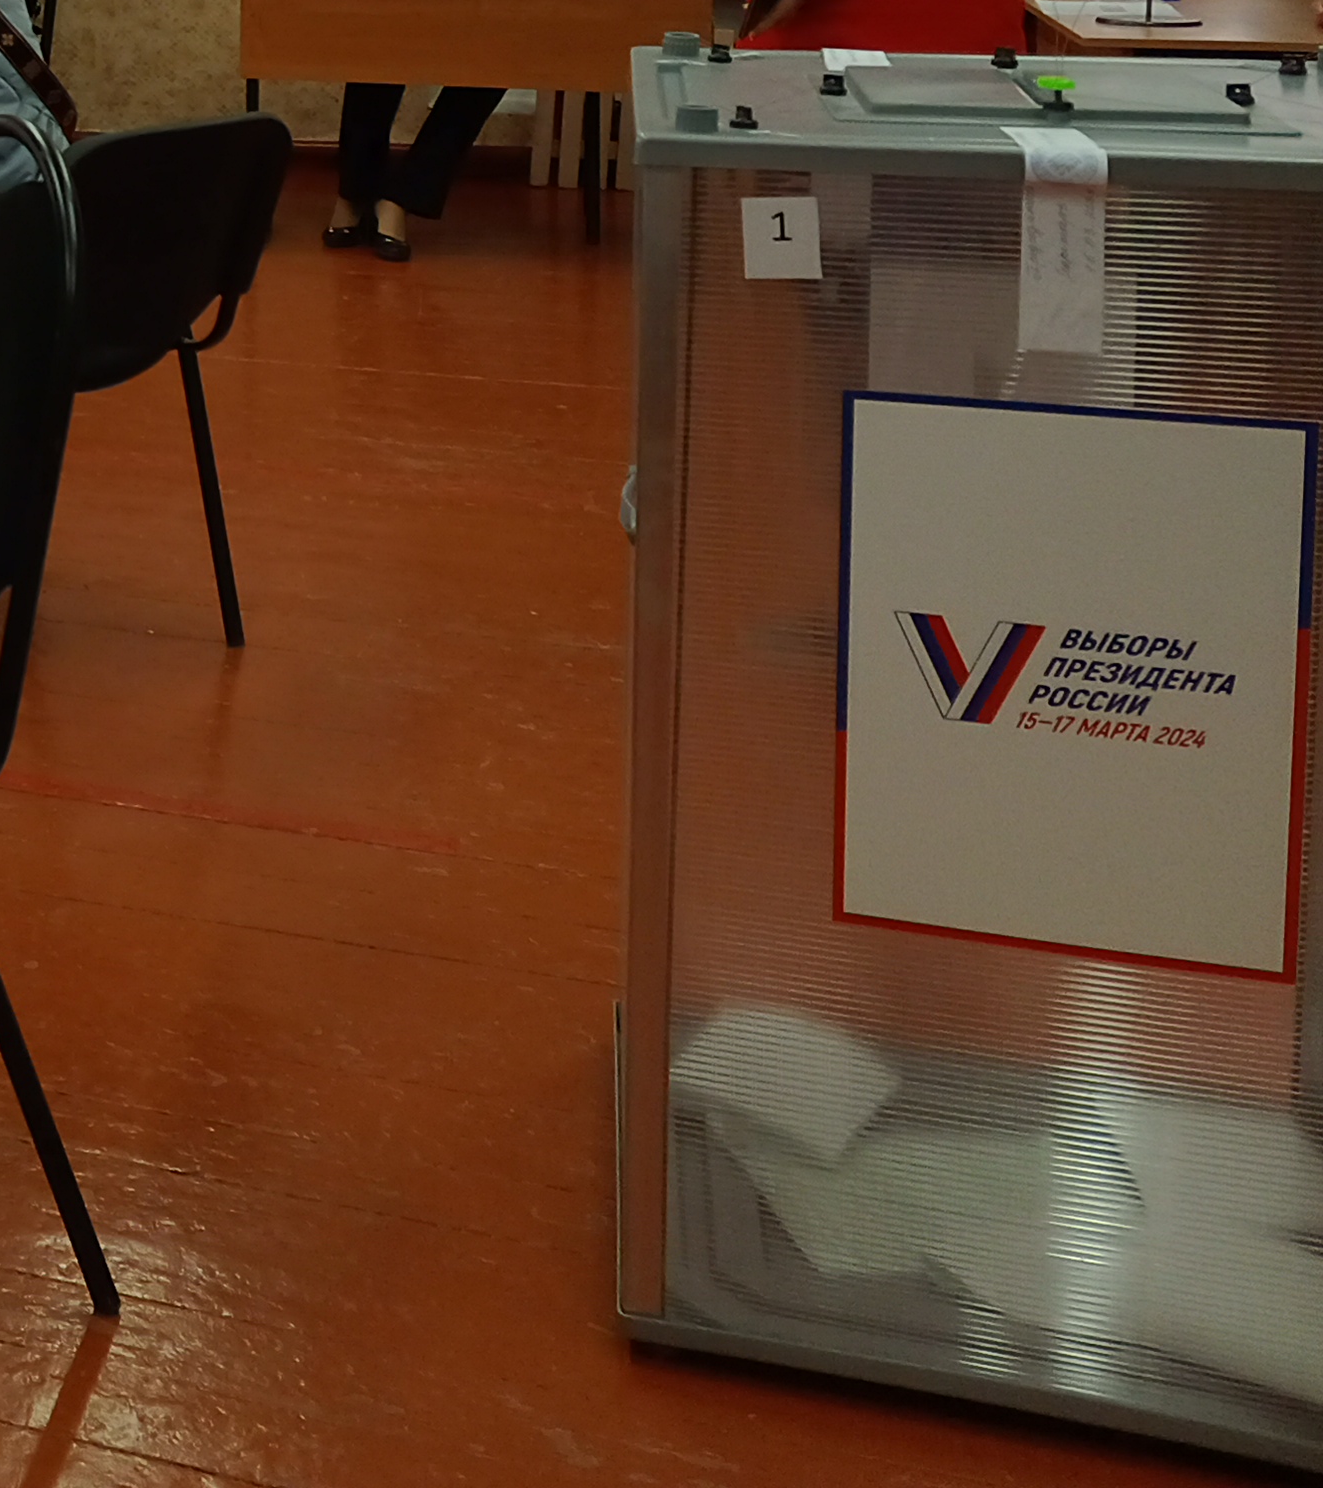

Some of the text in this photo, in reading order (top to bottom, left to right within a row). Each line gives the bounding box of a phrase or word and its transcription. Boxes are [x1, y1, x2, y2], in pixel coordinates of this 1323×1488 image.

[771, 211, 793, 241] 1
[1060, 628, 1198, 661] ВЫБОРЫ
[1043, 656, 1237, 696] ПРЕЗИДЕНТА
[1028, 684, 1153, 717] РОССИИ
[1076, 717, 1152, 743] МАРТА
[1152, 726, 1208, 749] 2024
